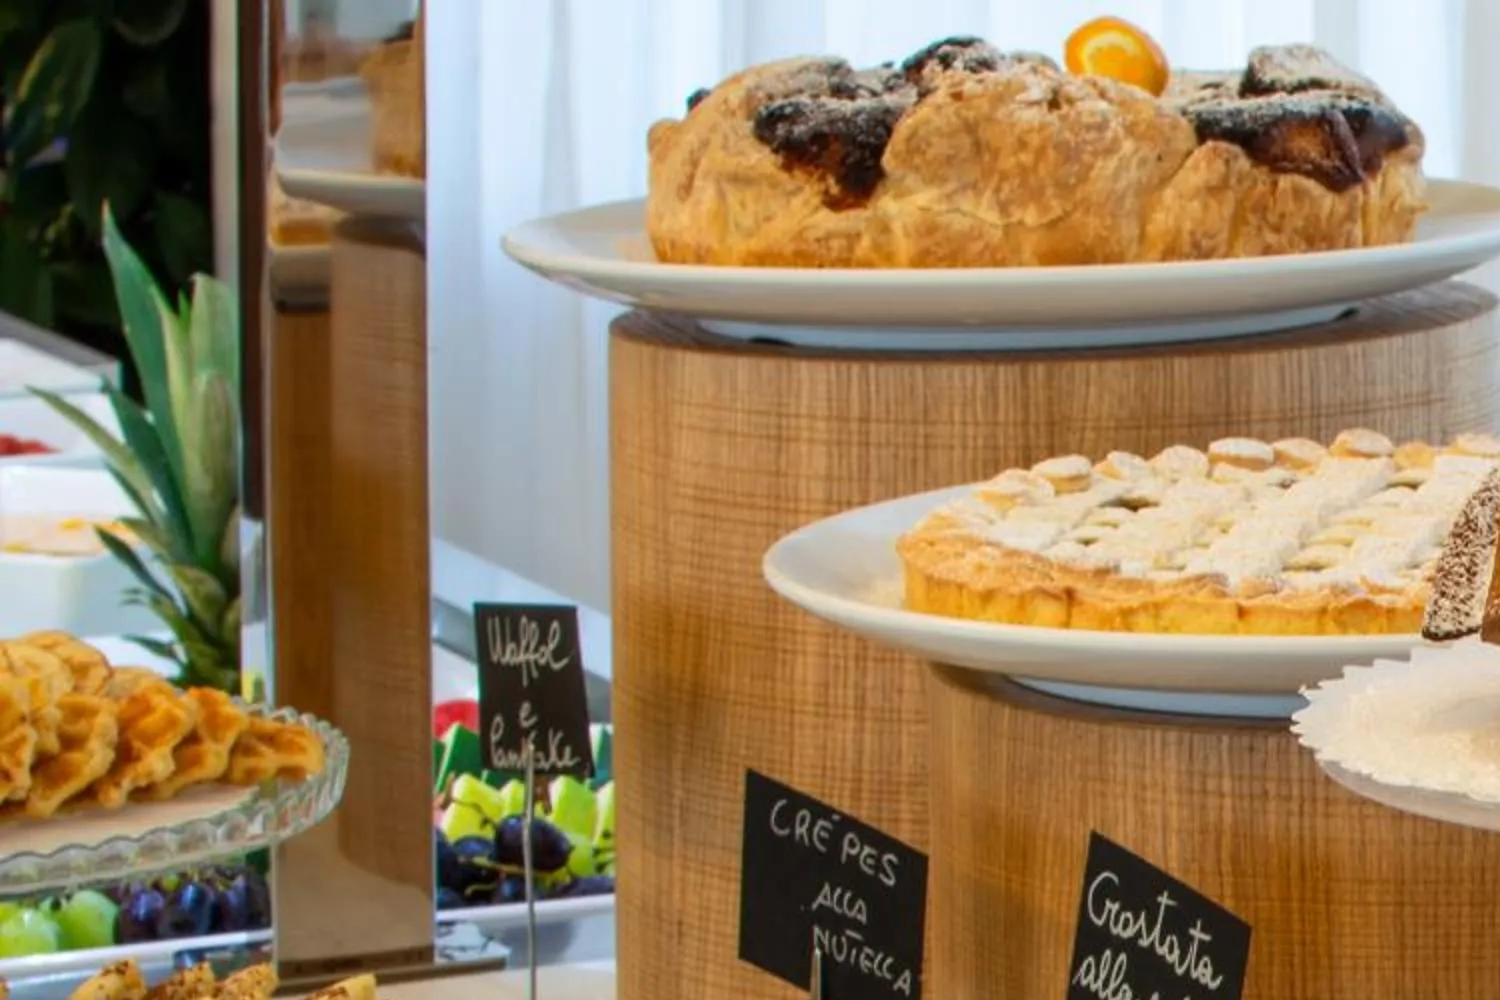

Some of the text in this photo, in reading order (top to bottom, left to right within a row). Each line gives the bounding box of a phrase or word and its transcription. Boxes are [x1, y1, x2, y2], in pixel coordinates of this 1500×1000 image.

[519, 701, 538, 728] e
[811, 882, 868, 925] ALLA
[1087, 871, 1224, 990] Crostata
[812, 924, 914, 997] NUTELLA
